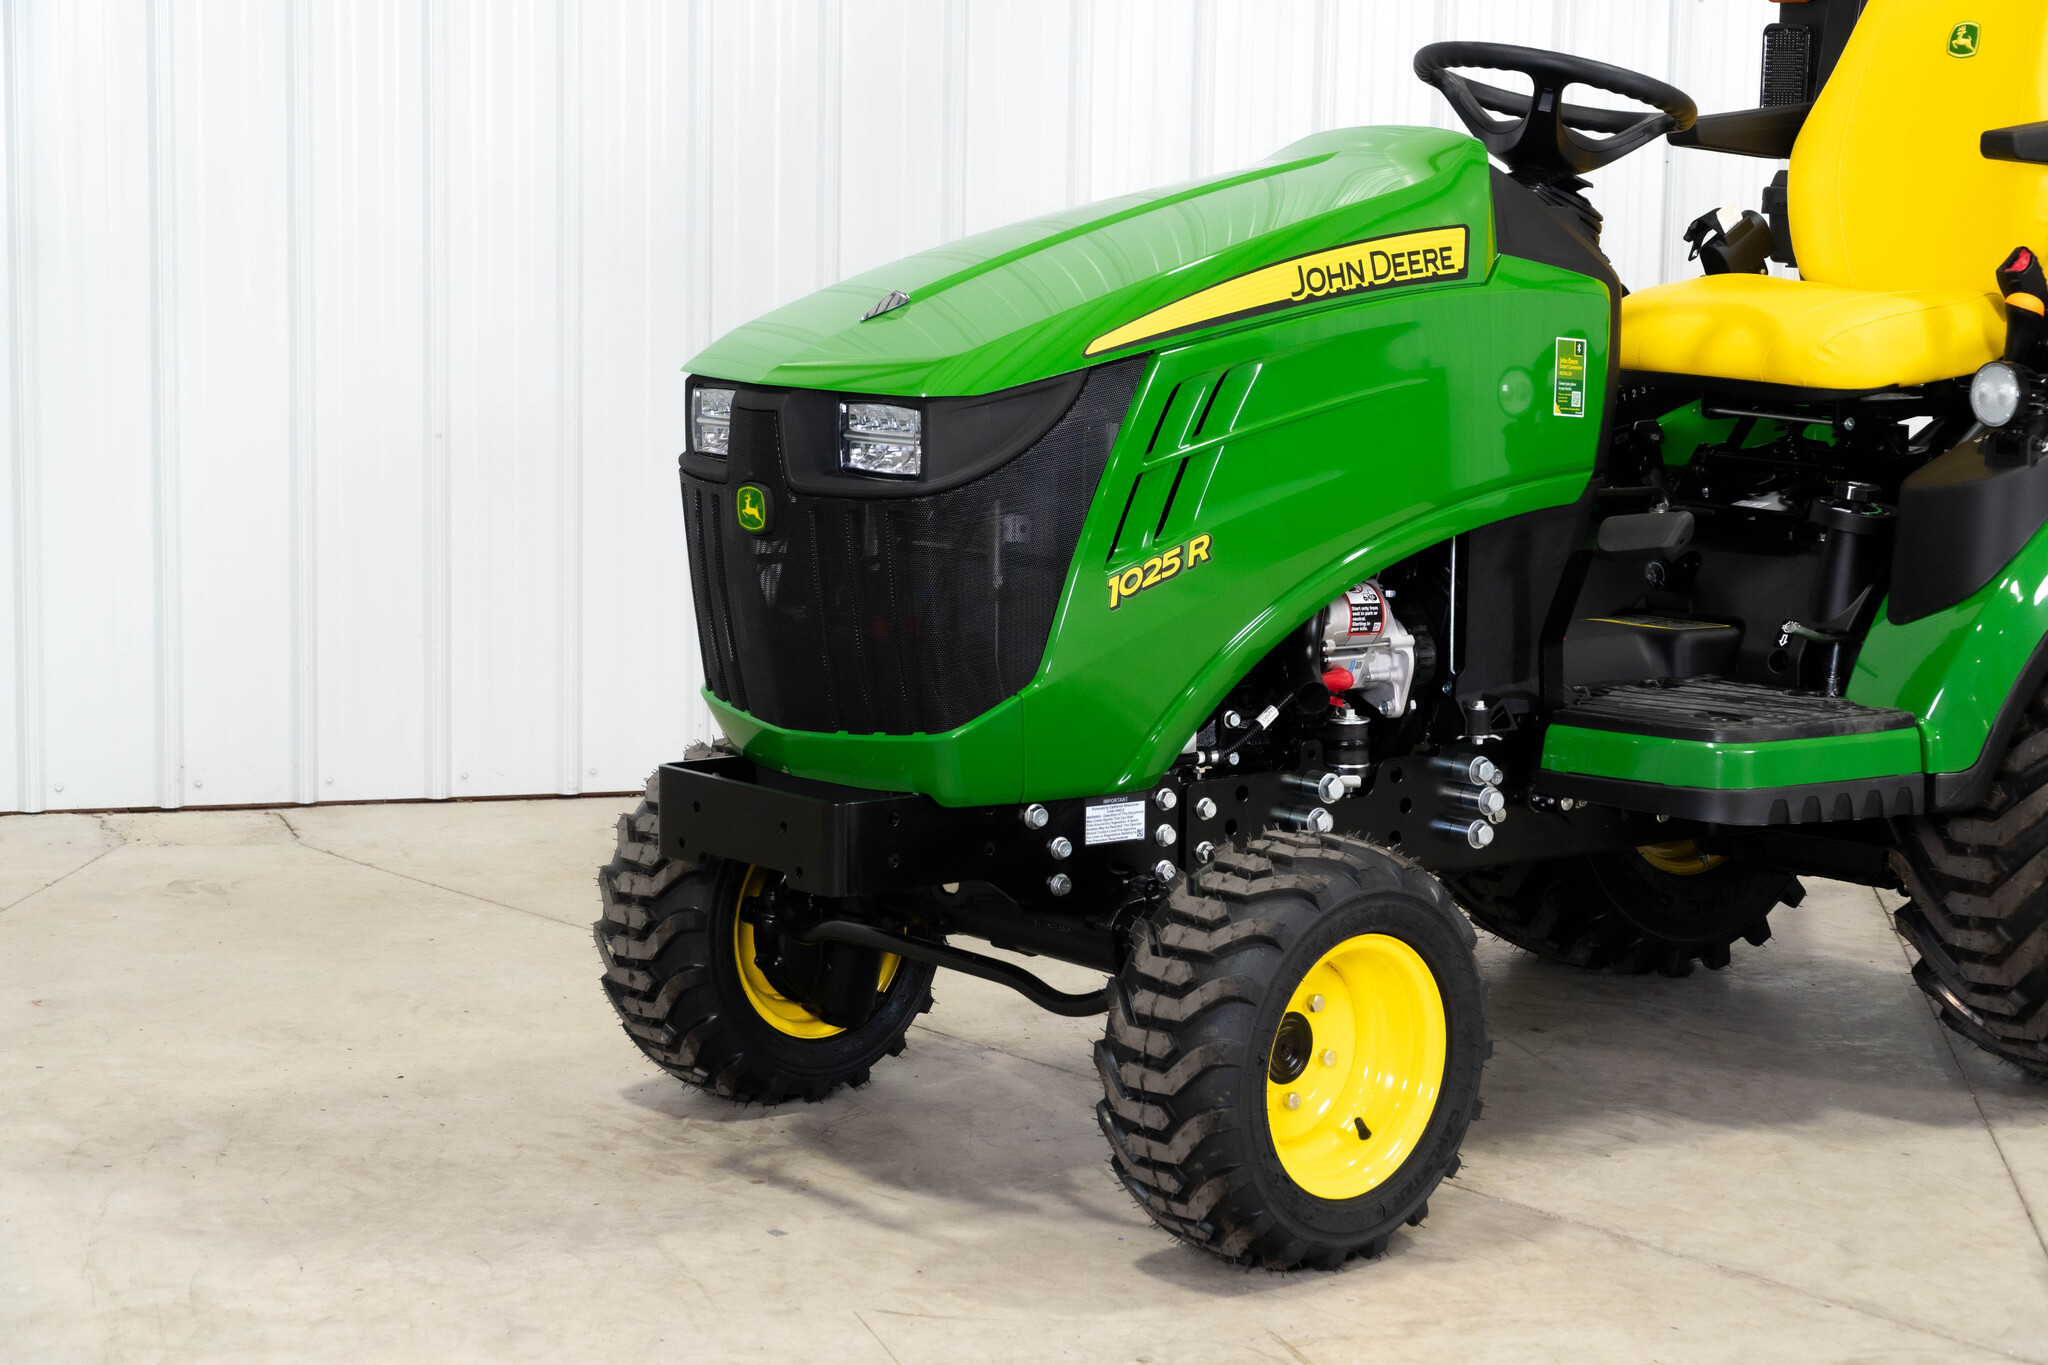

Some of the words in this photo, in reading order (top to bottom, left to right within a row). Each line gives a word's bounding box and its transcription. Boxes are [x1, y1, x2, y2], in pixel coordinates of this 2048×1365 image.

[1291, 259, 1366, 298] JOHN
[1369, 246, 1456, 281] DEERE
[1622, 393, 1626, 401] 1
[1632, 389, 1637, 398] 2
[1108, 545, 1184, 611] 1025
[1187, 532, 1212, 570] R
